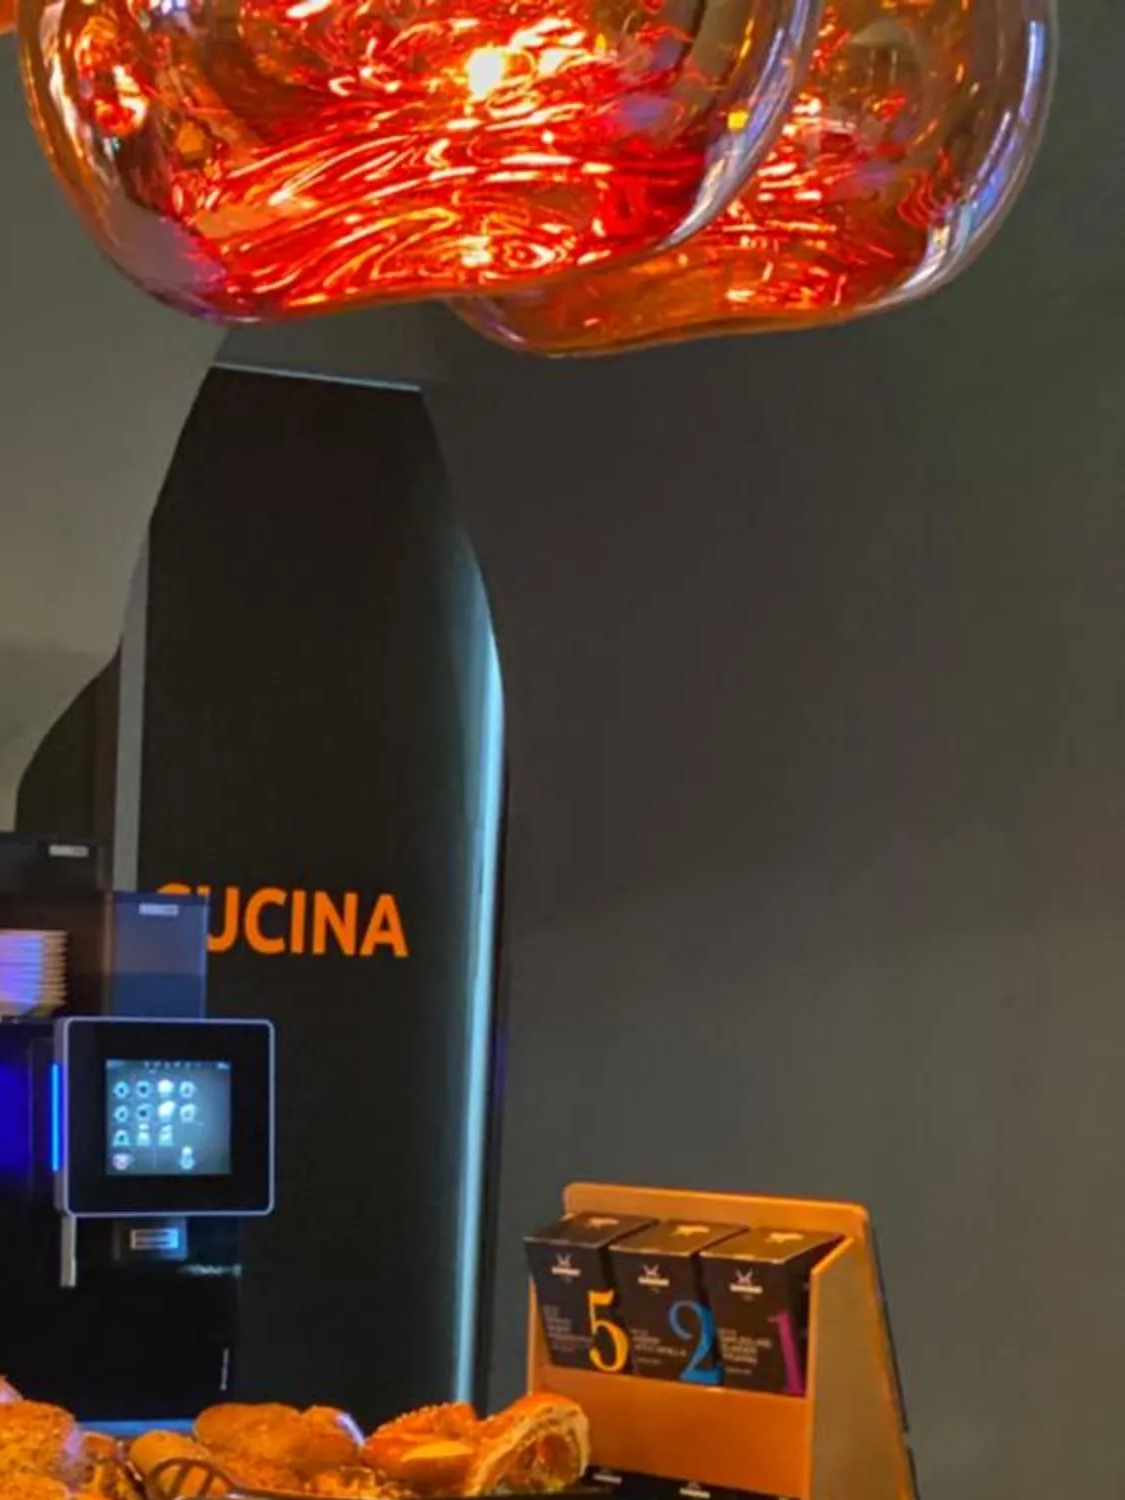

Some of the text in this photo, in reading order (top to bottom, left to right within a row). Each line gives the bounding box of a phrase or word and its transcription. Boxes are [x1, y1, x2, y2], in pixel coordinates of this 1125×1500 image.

[156, 882, 409, 957] UCINA
[588, 1288, 628, 1372] 5
[669, 1301, 721, 1384] 2
